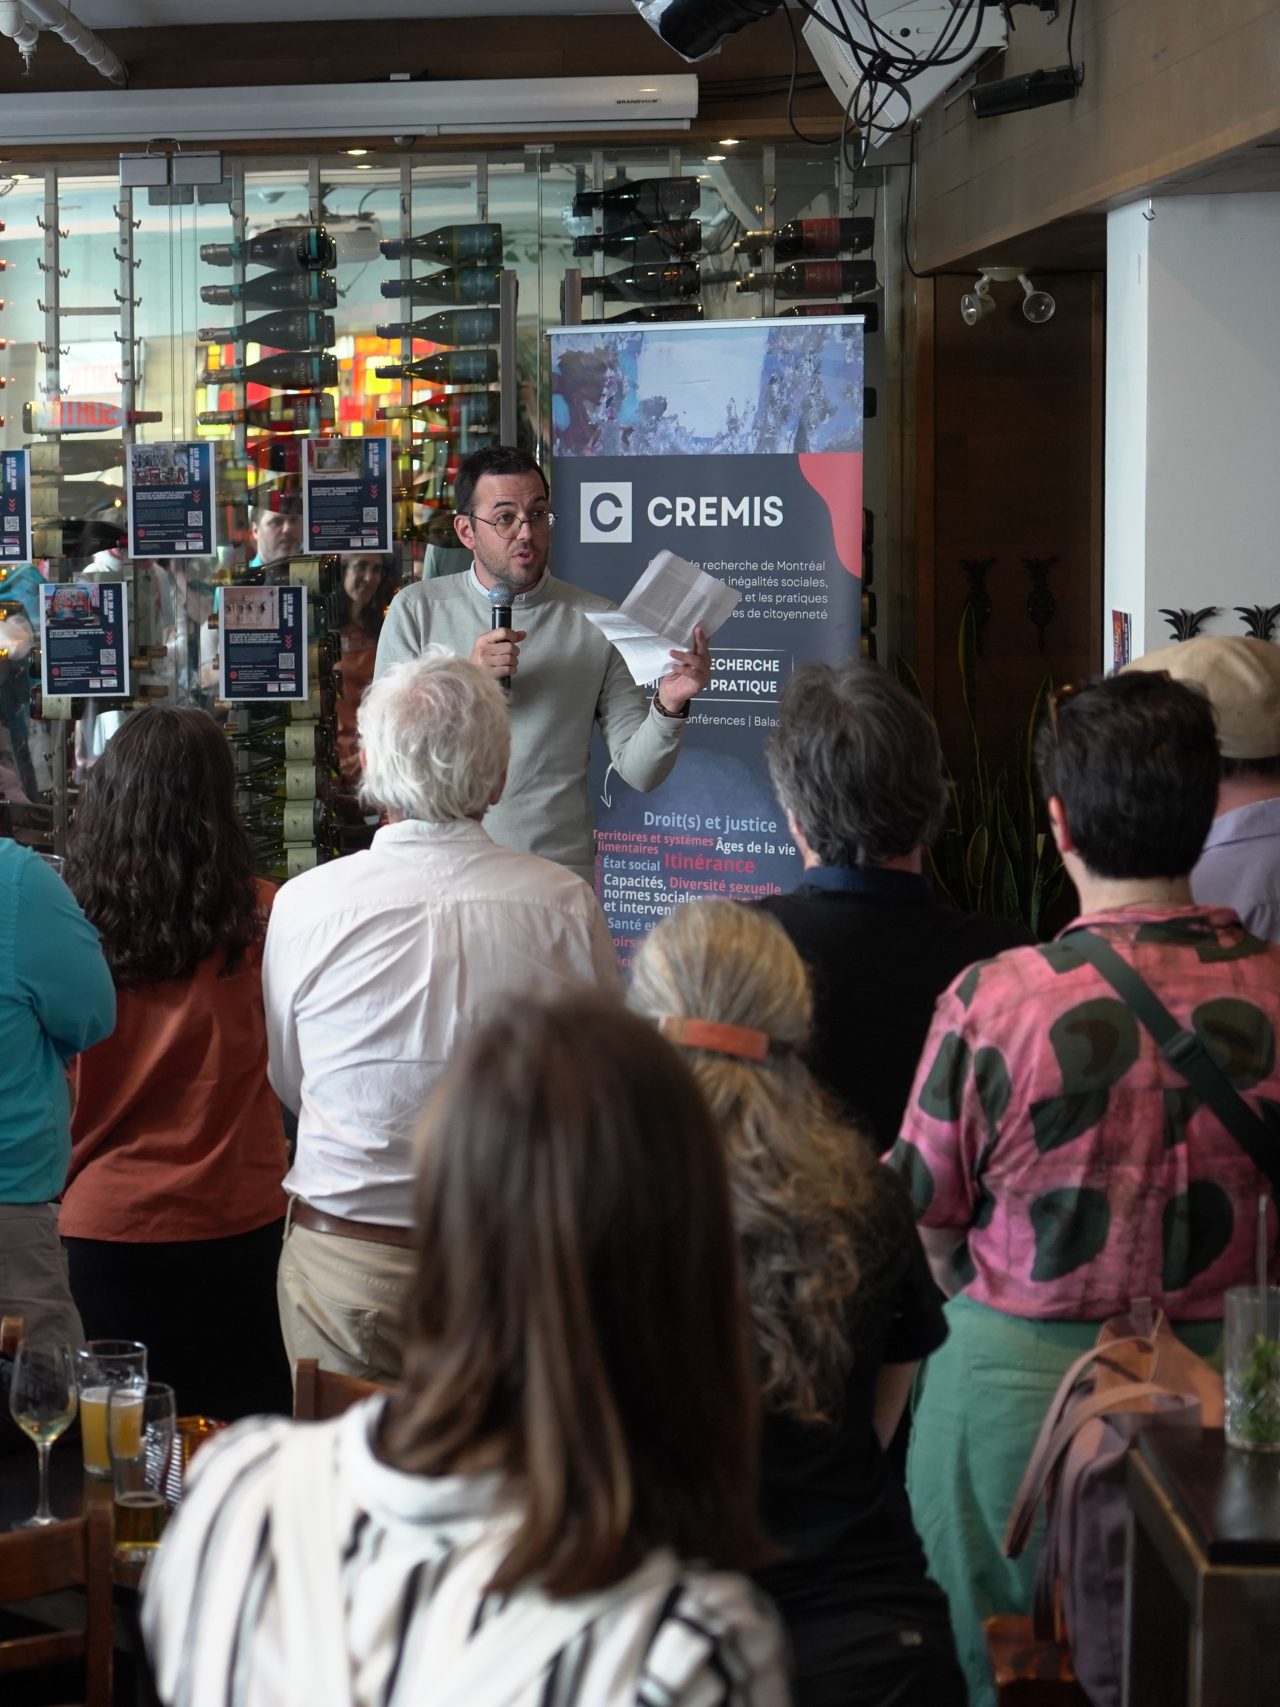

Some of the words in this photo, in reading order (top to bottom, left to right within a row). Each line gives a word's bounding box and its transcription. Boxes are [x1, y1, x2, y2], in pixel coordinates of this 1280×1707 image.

[647, 495, 784, 527] CREMIS
[702, 559, 759, 571] recherche
[761, 559, 774, 571] de
[776, 559, 826, 571] Montréal
[728, 575, 779, 588] inégalités
[781, 576, 829, 588] sociales,
[745, 593, 756, 603] et
[758, 592, 773, 603] les
[775, 593, 828, 605] pratiques
[747, 609, 761, 619] de
[763, 609, 828, 621] citoyenneté
[710, 658, 780, 672] ECHERCHE
[711, 679, 777, 695] PRATIQUE
[685, 714, 746, 727] onférences
[644, 811, 701, 831] Droit(s)
[705, 814, 721, 830] et
[724, 815, 777, 834] justice
[592, 829, 648, 843] Territoires
[650, 831, 661, 844] et
[663, 832, 714, 848] systèmes
[598, 841, 659, 855] limentaires
[715, 837, 744, 857] Âges
[746, 839, 761, 853] de
[764, 841, 776, 854] la
[778, 843, 796, 856] vie
[603, 854, 626, 869] État
[628, 859, 661, 872] social
[664, 852, 756, 874] Itinérance
[604, 873, 667, 890] Capacités,
[670, 876, 726, 893] Diversité
[729, 881, 782, 895] sexuelle
[603, 888, 651, 901] normes
[603, 901, 617, 912] et
[607, 917, 642, 930] Santé
[644, 921, 657, 931] et
